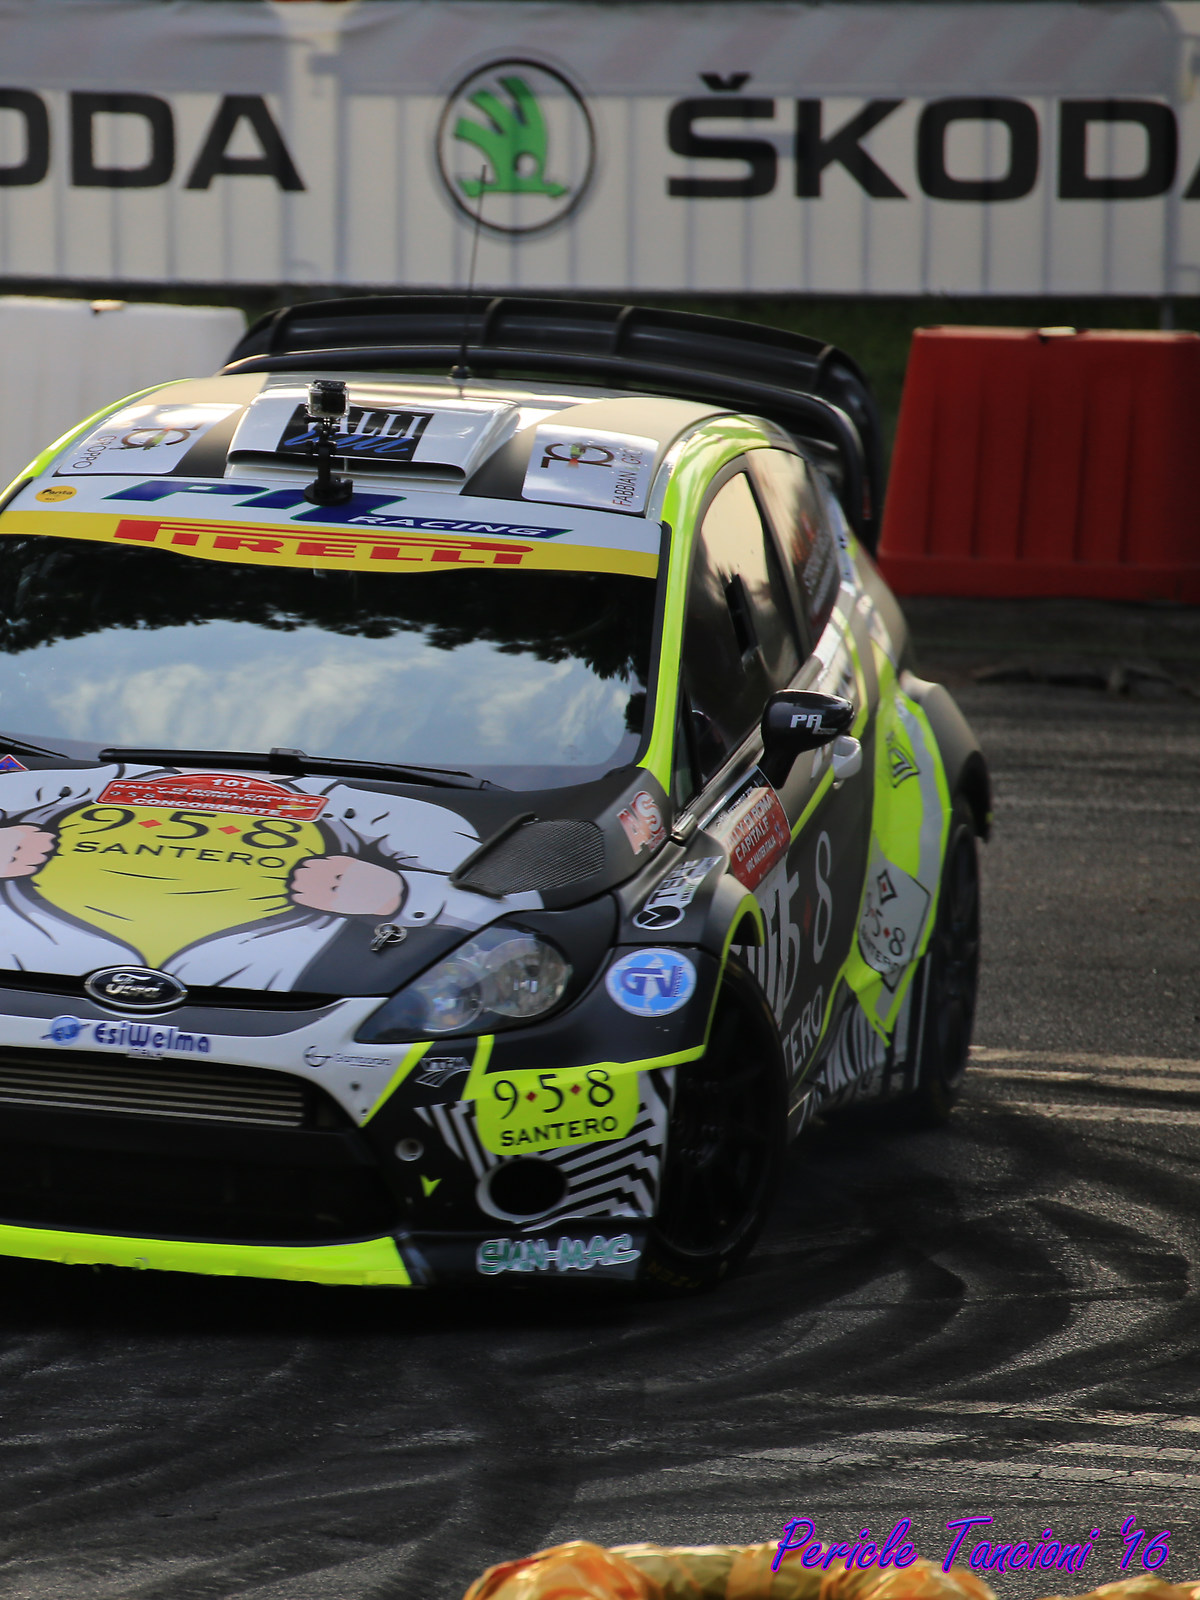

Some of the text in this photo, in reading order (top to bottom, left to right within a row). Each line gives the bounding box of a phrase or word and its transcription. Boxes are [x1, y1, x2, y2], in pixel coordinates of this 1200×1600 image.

[665, 73, 1200, 201] ŠKOD
[347, 515, 548, 537] RACING
[113, 519, 535, 565] PIRELLI
[190, 788, 238, 796] ROMA
[242, 792, 320, 803] CAPITALE
[212, 778, 251, 788] 101
[132, 798, 282, 815] CONCORRENTE
[74, 842, 285, 869] SANTERO
[106, 973, 165, 998] Ford
[501, 1115, 619, 1147] SANTERO
